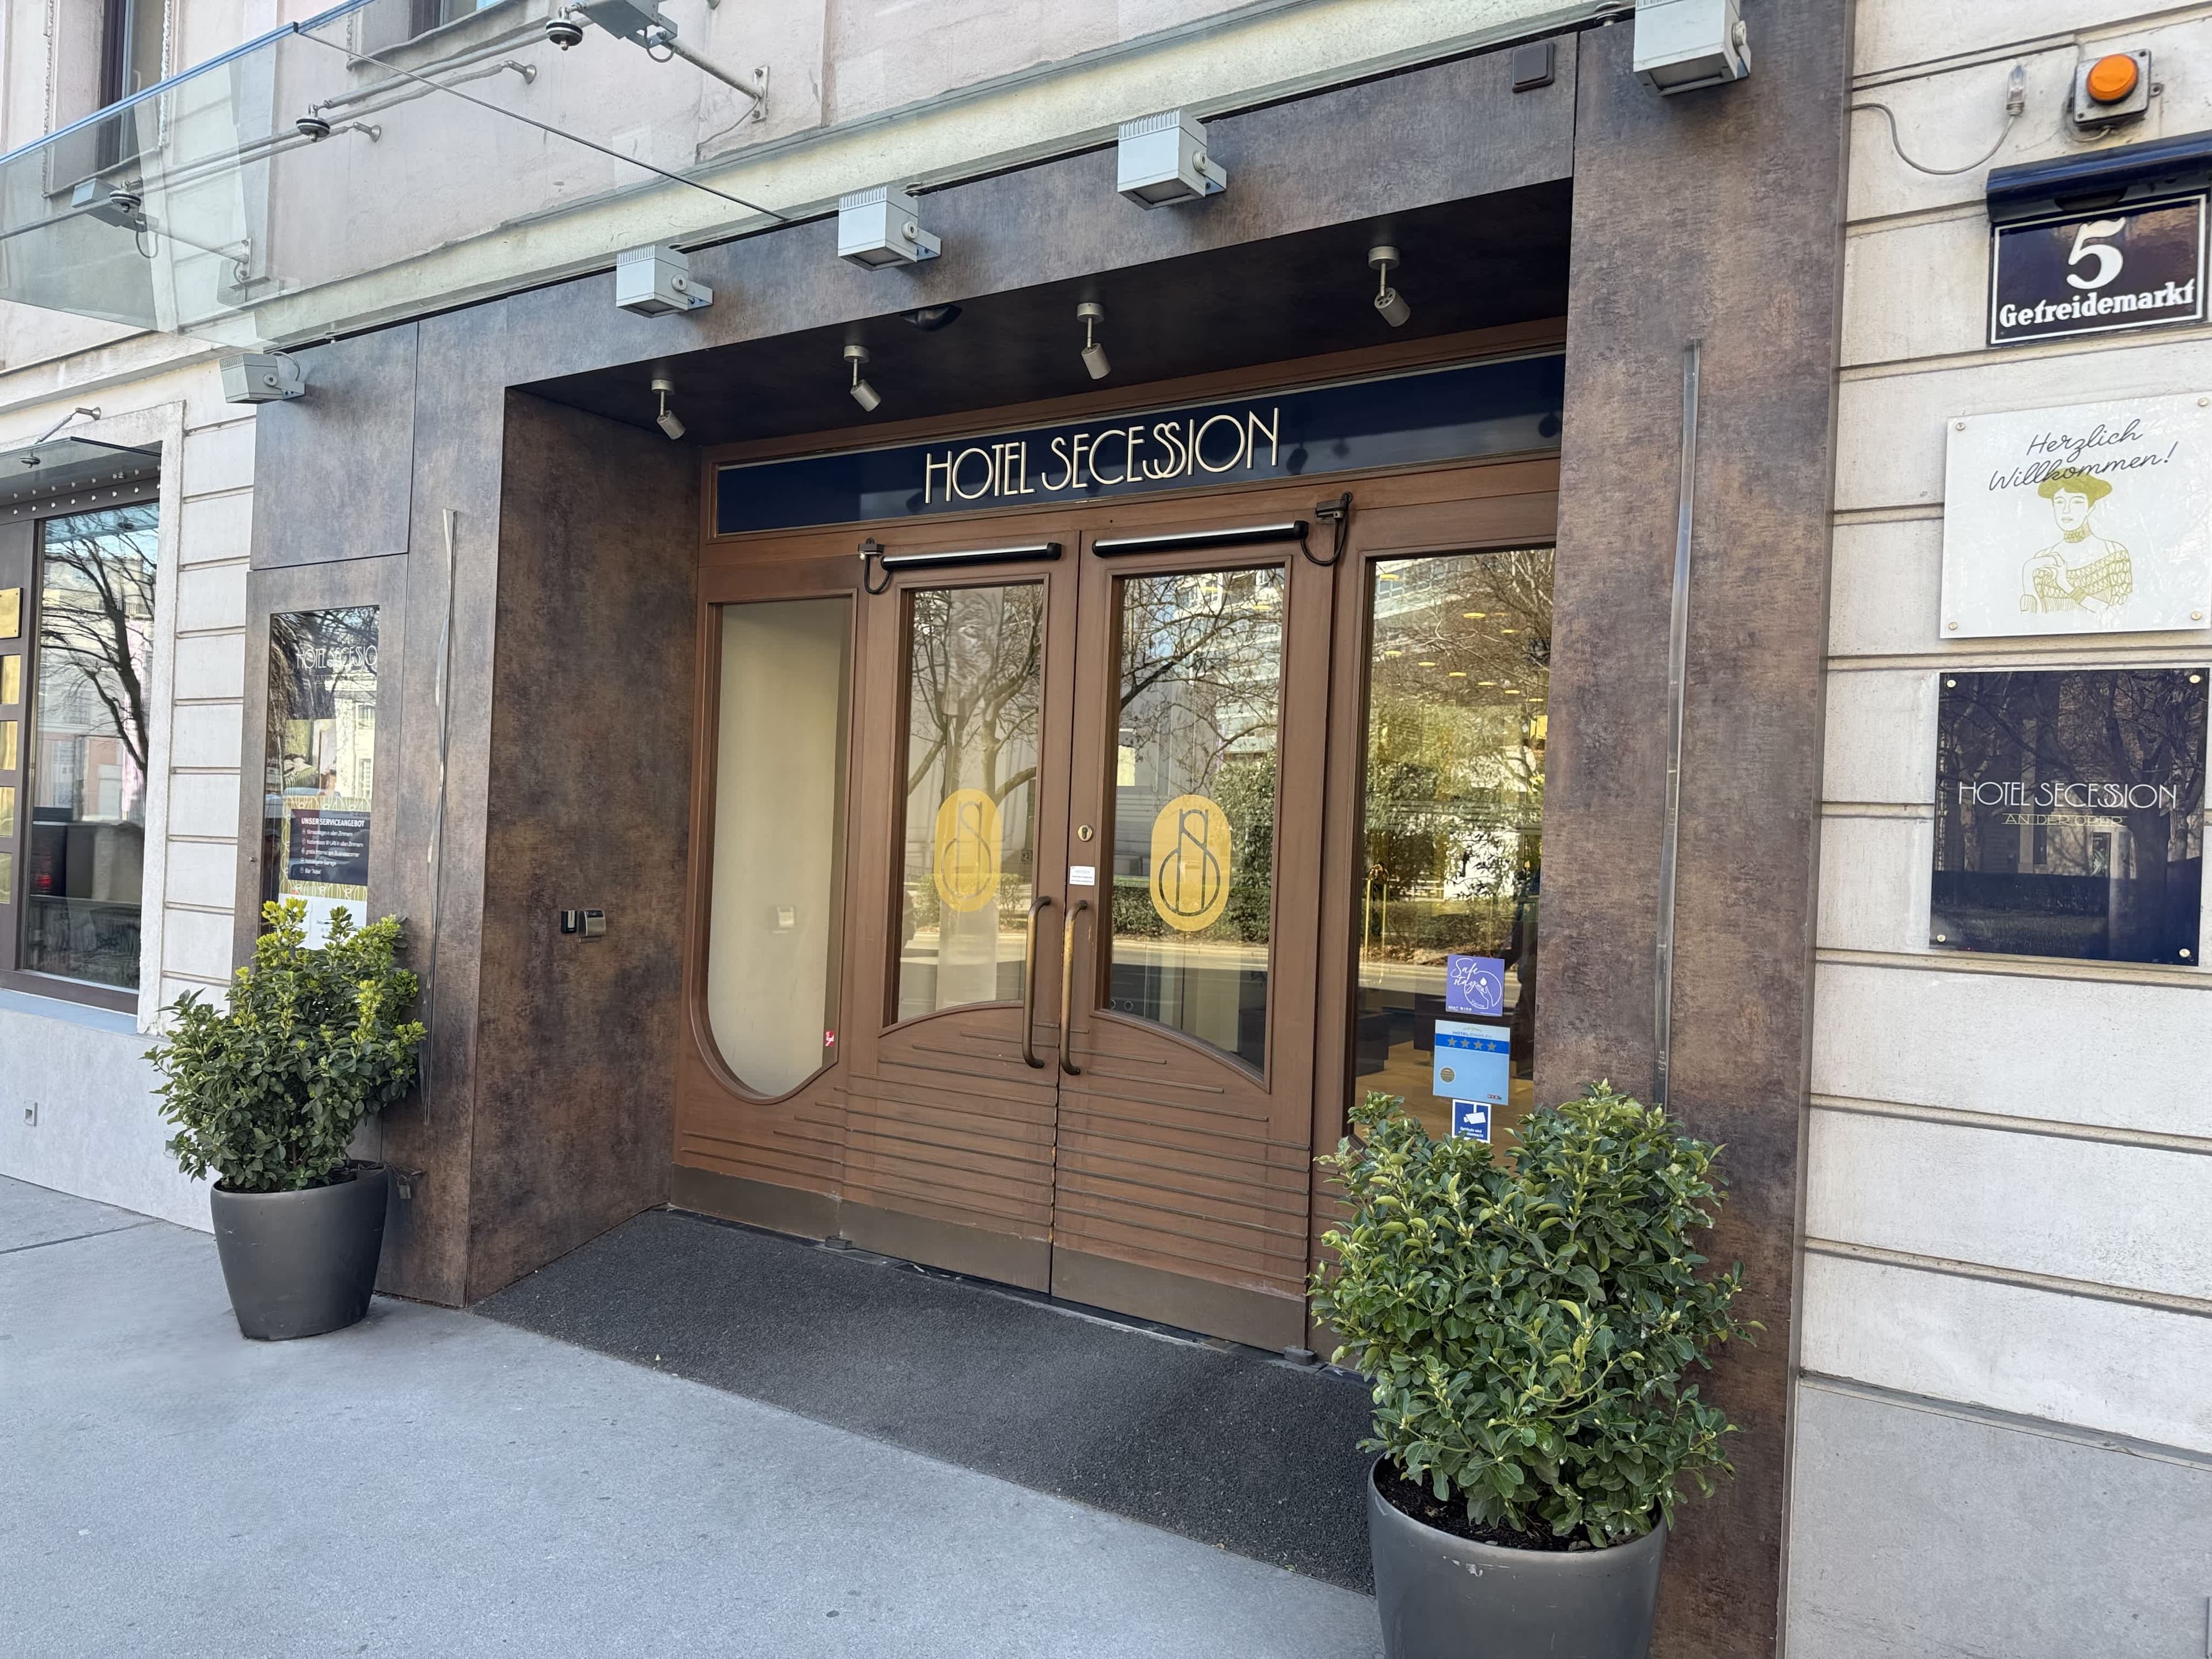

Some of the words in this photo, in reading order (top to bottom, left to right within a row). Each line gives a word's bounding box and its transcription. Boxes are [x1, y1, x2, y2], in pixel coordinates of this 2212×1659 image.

[2066, 217, 2126, 289] 5
[1999, 278, 2195, 328] Getreidemarkt
[2026, 418, 2144, 463] Herzlich
[925, 441, 1036, 504] HOTEL
[1041, 407, 1279, 491] SECESSION
[1989, 441, 2179, 491] Willkommen!
[296, 648, 327, 669] HOTEL
[327, 645, 378, 668] SECESSIO
[1959, 782, 2031, 806] HOTEL
[2035, 783, 2177, 809] SECESSION
[320, 819, 365, 827] SERVICEANGEBOT
[2005, 814, 2029, 824] AN
[2037, 815, 2070, 825] DER
[2074, 816, 2126, 827] OPER
[1450, 957, 1478, 980] Safe
[1453, 976, 1478, 994] stay
